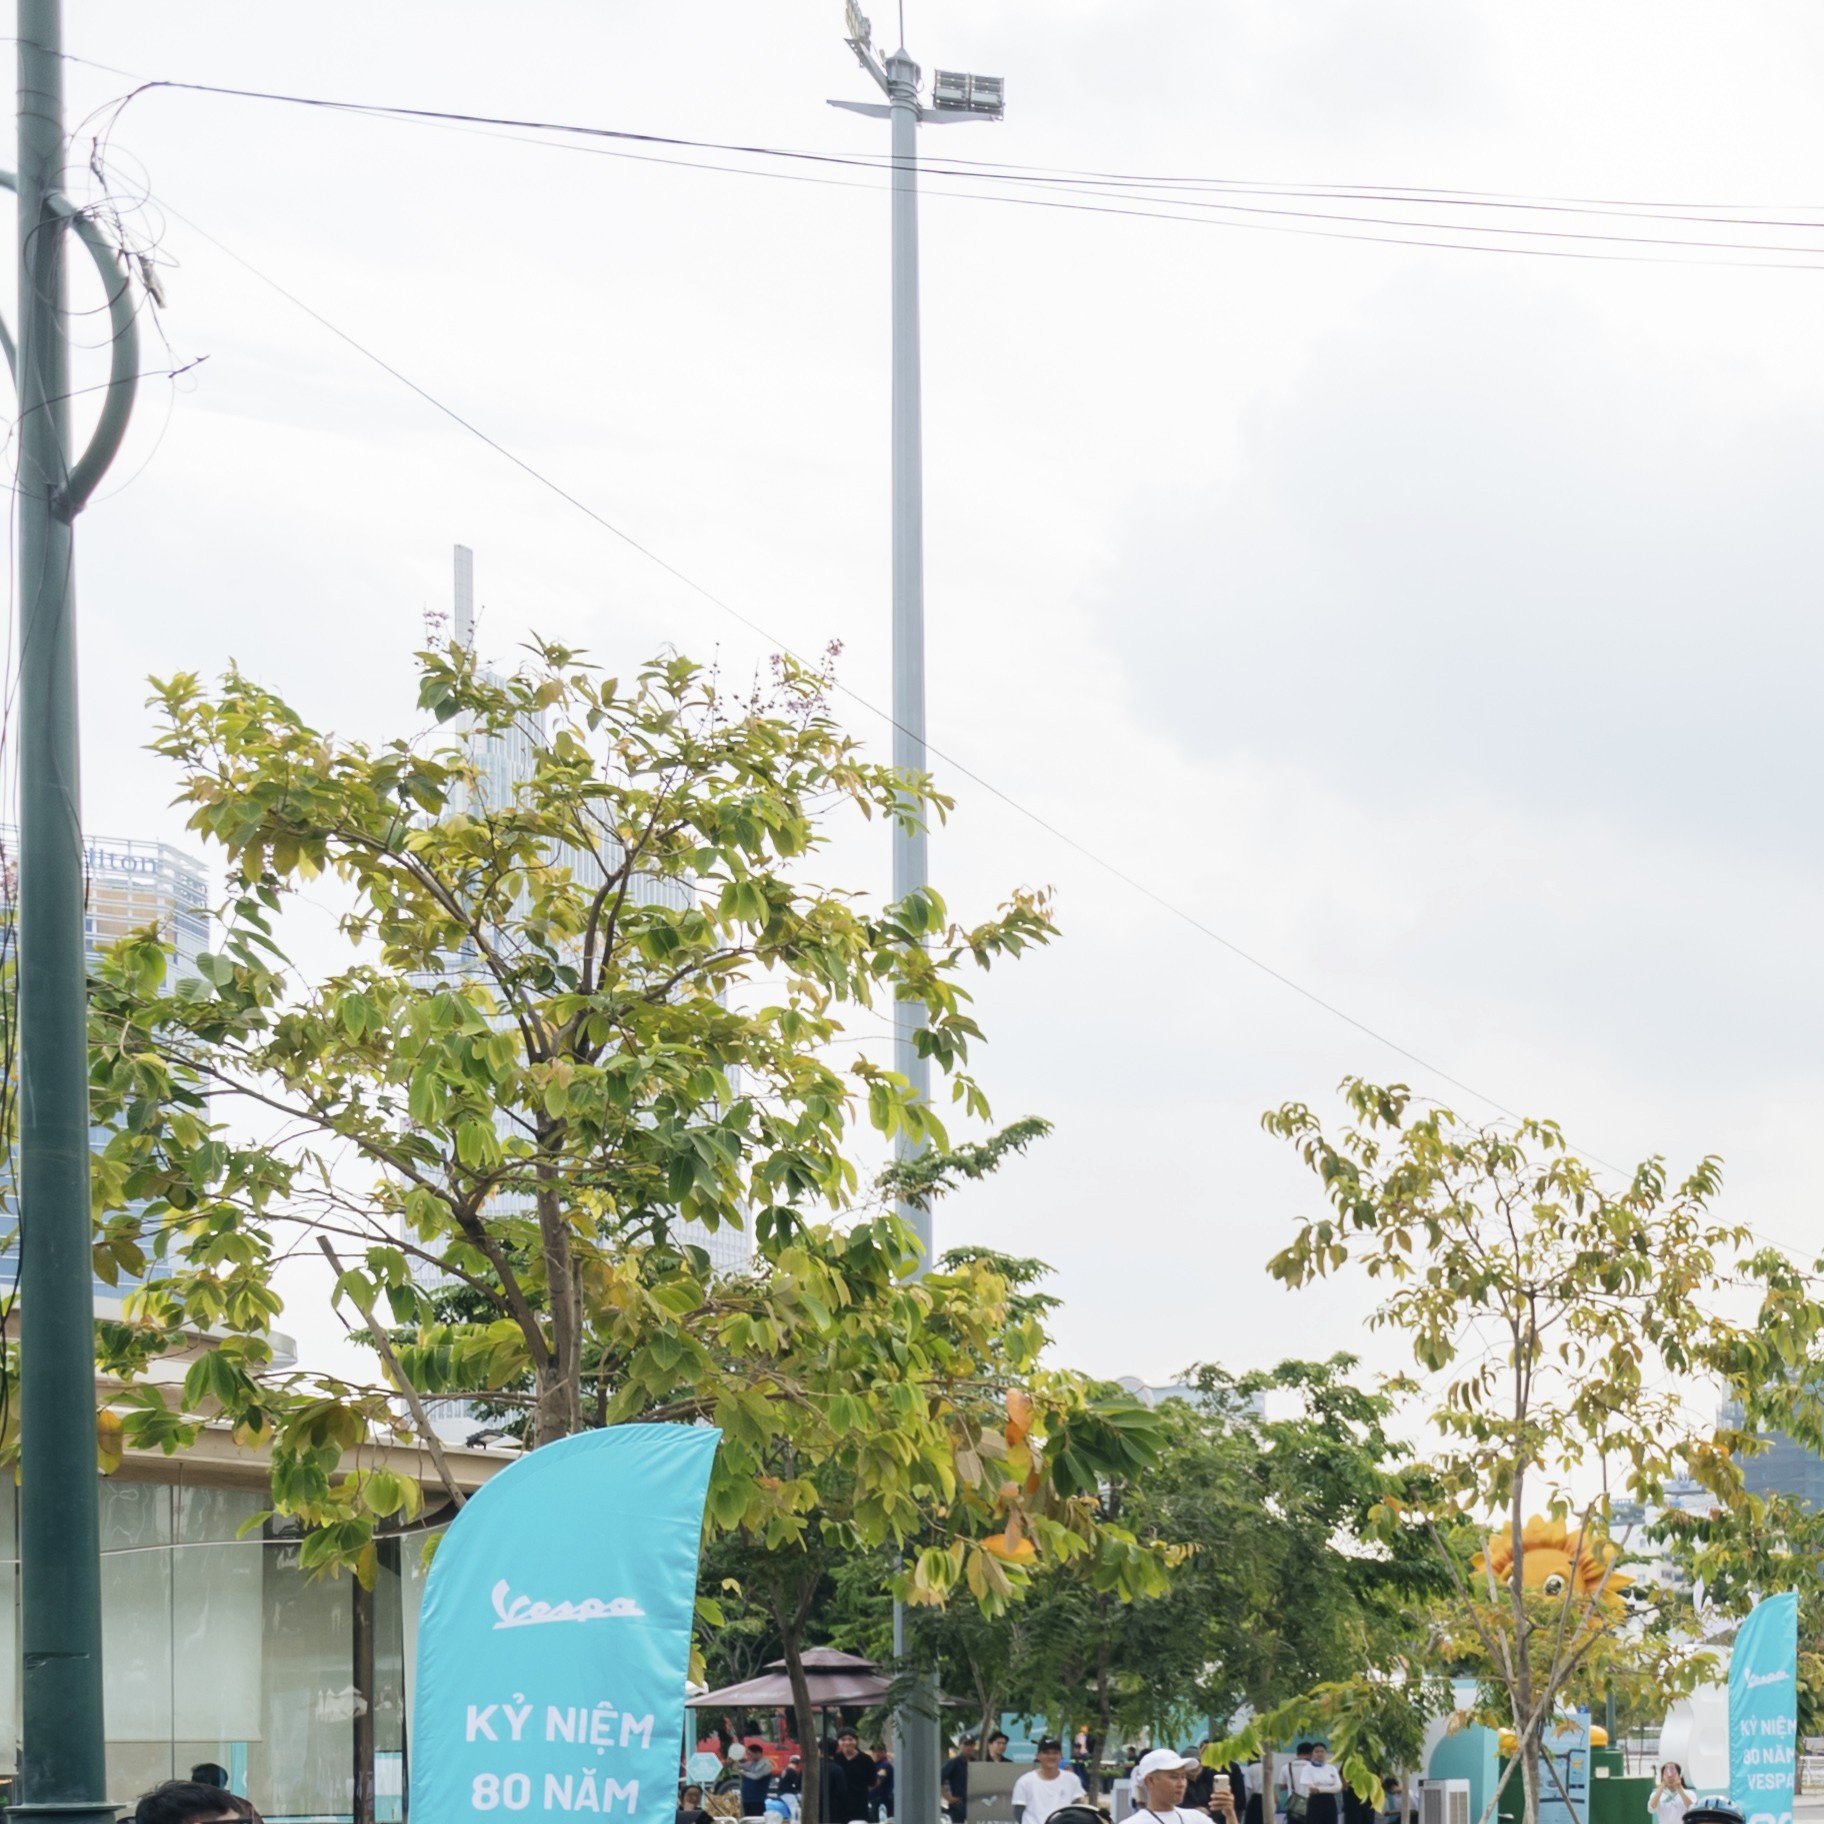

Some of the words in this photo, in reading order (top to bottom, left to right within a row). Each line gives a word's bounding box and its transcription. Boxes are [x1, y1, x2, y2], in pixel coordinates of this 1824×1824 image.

[491, 1579, 646, 1630] Vespa
[465, 1692, 533, 1742] KỶ
[545, 1701, 655, 1755] NIỆM
[471, 1773, 531, 1811] 80
[543, 1767, 640, 1815] NĂM
